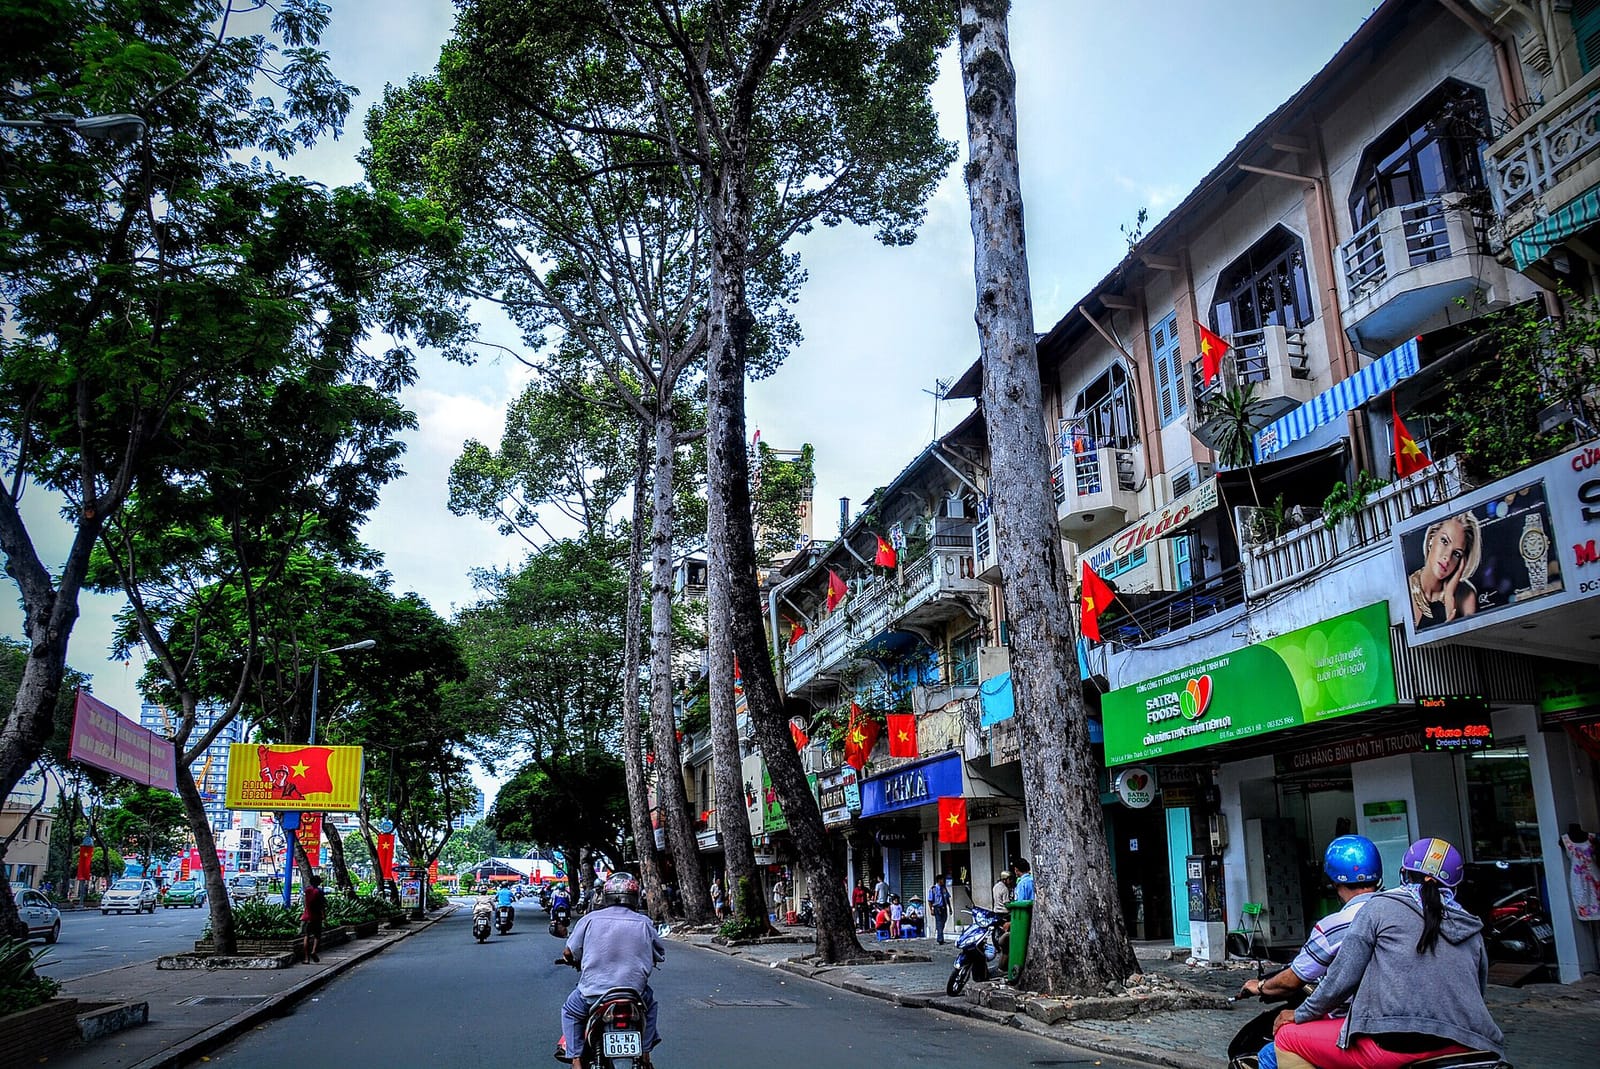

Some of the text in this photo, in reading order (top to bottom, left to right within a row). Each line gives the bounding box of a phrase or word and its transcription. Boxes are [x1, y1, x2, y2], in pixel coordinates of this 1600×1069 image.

[1113, 505, 1195, 556] Thảo
[1146, 692, 1179, 710] SATRA
[1423, 698, 1445, 707] Tailor's
[1147, 705, 1180, 723] FOODS
[1425, 725, 1462, 738] Thao
[1436, 738, 1460, 747] Ordered
[611, 1044, 636, 1054] 0059
